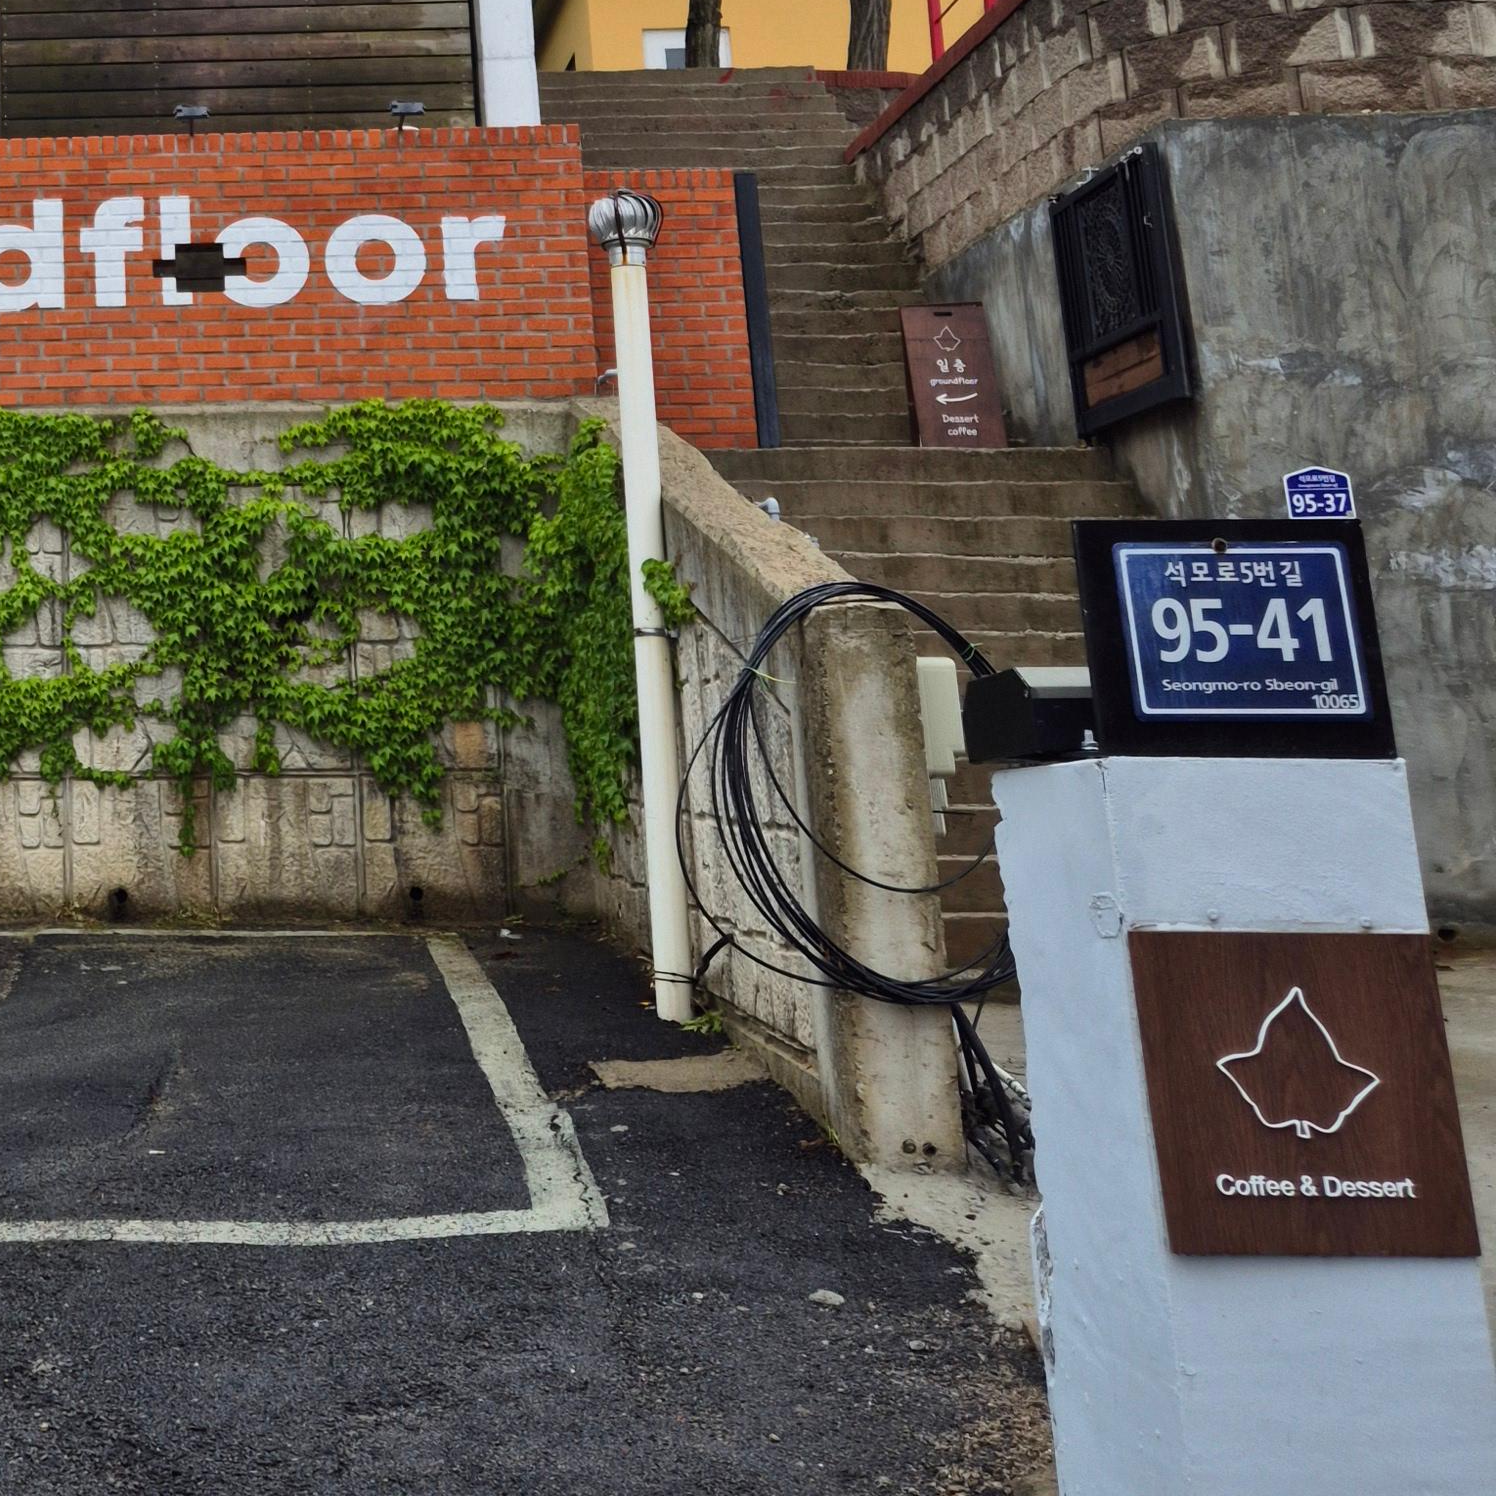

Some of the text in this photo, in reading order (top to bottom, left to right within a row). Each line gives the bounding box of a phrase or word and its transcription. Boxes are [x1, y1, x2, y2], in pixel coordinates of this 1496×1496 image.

[942, 414, 979, 423] Dessert
[1292, 493, 1346, 513] 95-37
[1164, 561, 1303, 587] 석모로5번길
[1151, 598, 1333, 663] 95-41
[1162, 679, 1261, 694] Seongmo-ro
[1311, 694, 1359, 709] 10065
[1215, 1174, 1417, 1198] Coffee & Dessert
